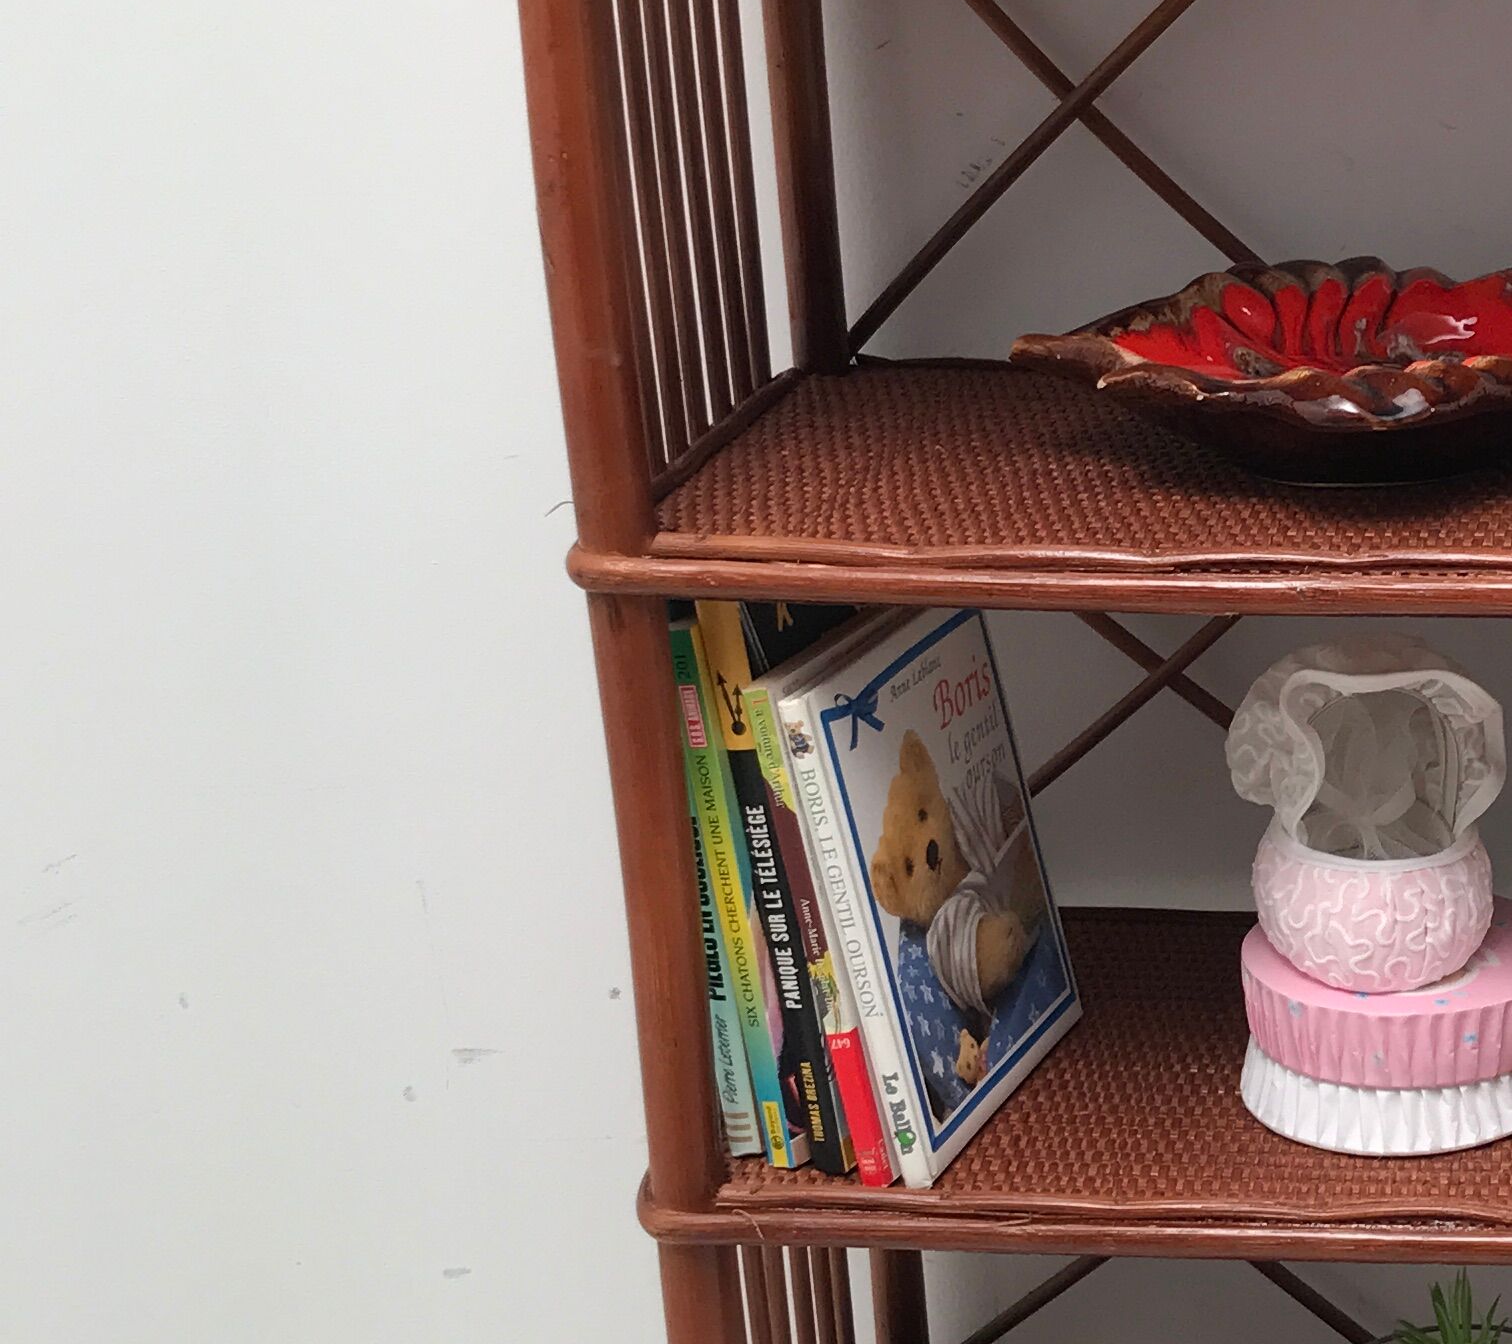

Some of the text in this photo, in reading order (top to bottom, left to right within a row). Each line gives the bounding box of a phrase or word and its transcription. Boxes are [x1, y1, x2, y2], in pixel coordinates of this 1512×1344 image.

[934, 654, 992, 730] Boris
[948, 700, 1000, 764] le gentil
[696, 755, 717, 812] MAISON
[965, 743, 1006, 790] ourson
[708, 815, 724, 845] UNE
[819, 835, 838, 861] LE
[714, 850, 742, 934] CHERCHENT
[746, 804, 803, 1009] PANIQUE SUR LE TÉLÉSIÈGE
[827, 865, 856, 936] GENTIL
[734, 938, 755, 1003] CHATONS
[845, 939, 879, 1017] OURSON
[746, 1006, 760, 1027] SIX
[831, 1037, 851, 1050] 647
[801, 1061, 826, 1142] THOMAS BREZINA
